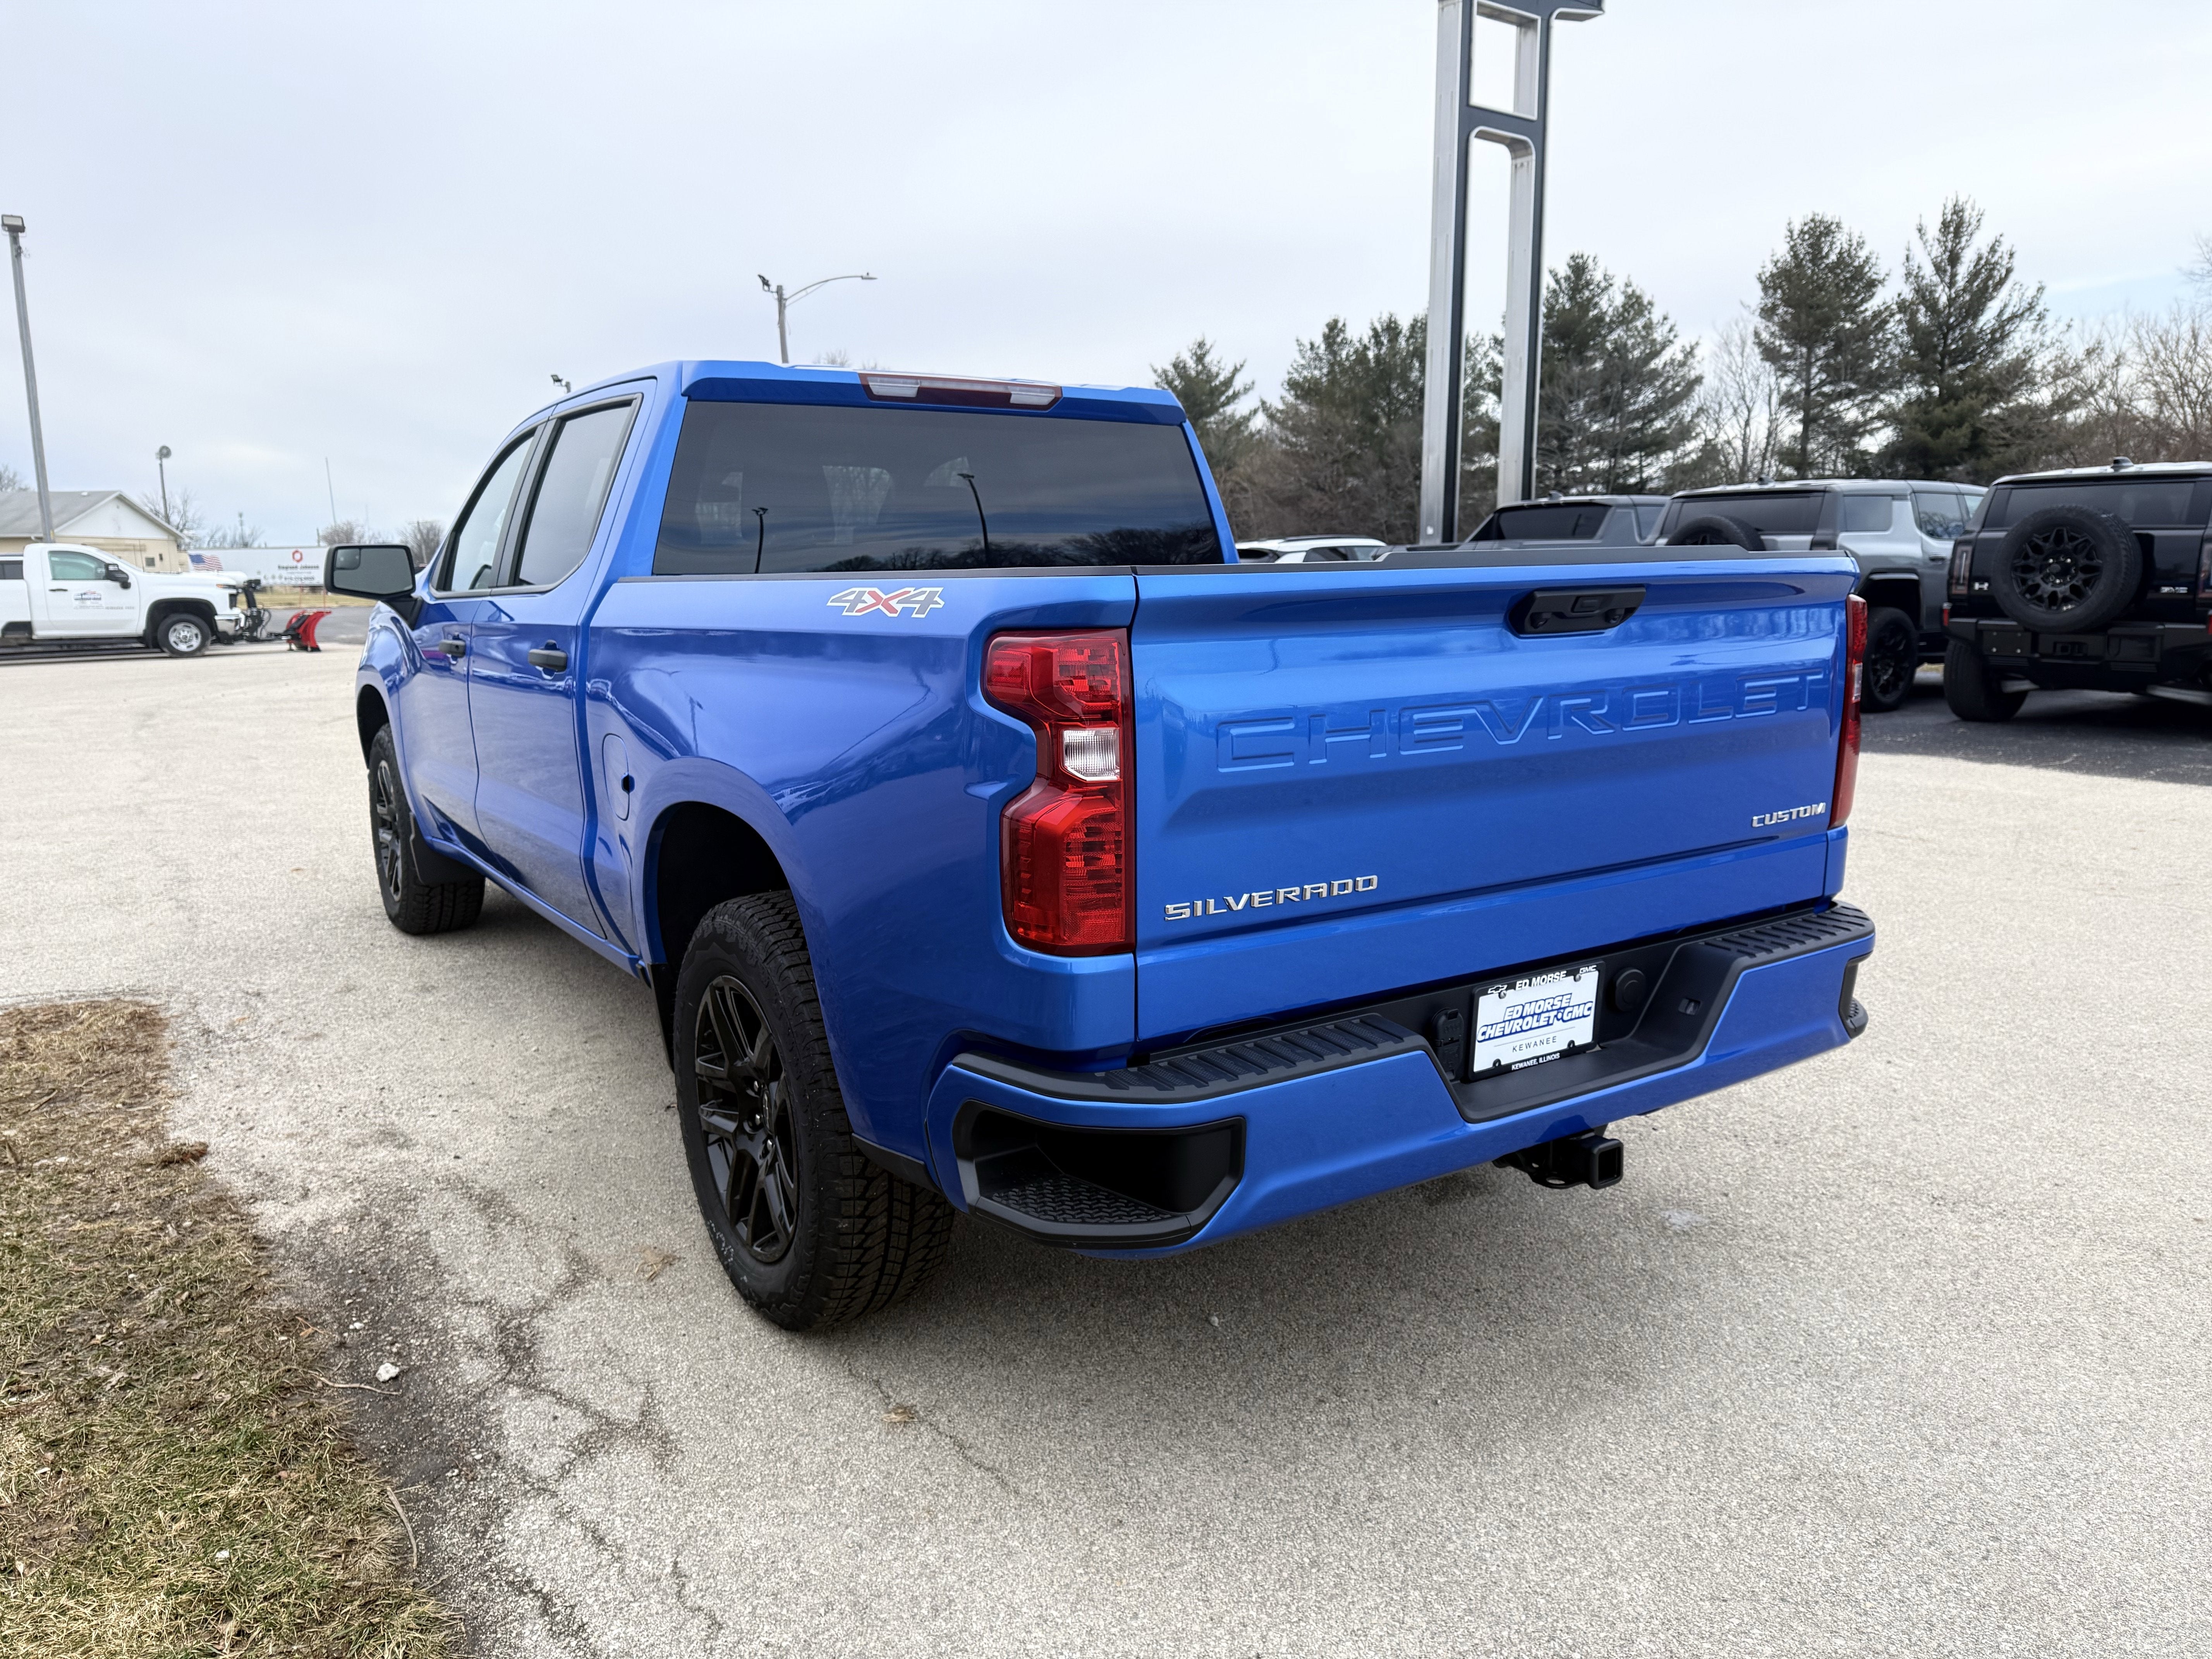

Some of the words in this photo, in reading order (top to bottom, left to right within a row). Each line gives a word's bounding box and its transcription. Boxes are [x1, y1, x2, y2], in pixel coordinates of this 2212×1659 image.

[1216, 668, 1824, 773] CHEVROLET
[1752, 802, 1826, 828] CUSTOM
[1164, 875, 1378, 921] SILVERADO
[1515, 981, 1529, 991] ED
[1531, 970, 1567, 988] MORSE
[1579, 965, 1597, 974] GMC
[1503, 1004, 1524, 1022] ED
[1522, 993, 1572, 1016] MORSE
[1512, 1036, 1557, 1053] KEWANEE
[1511, 1058, 1539, 1071] KEWANEE,
[1539, 1053, 1560, 1064] ILLINOIS
